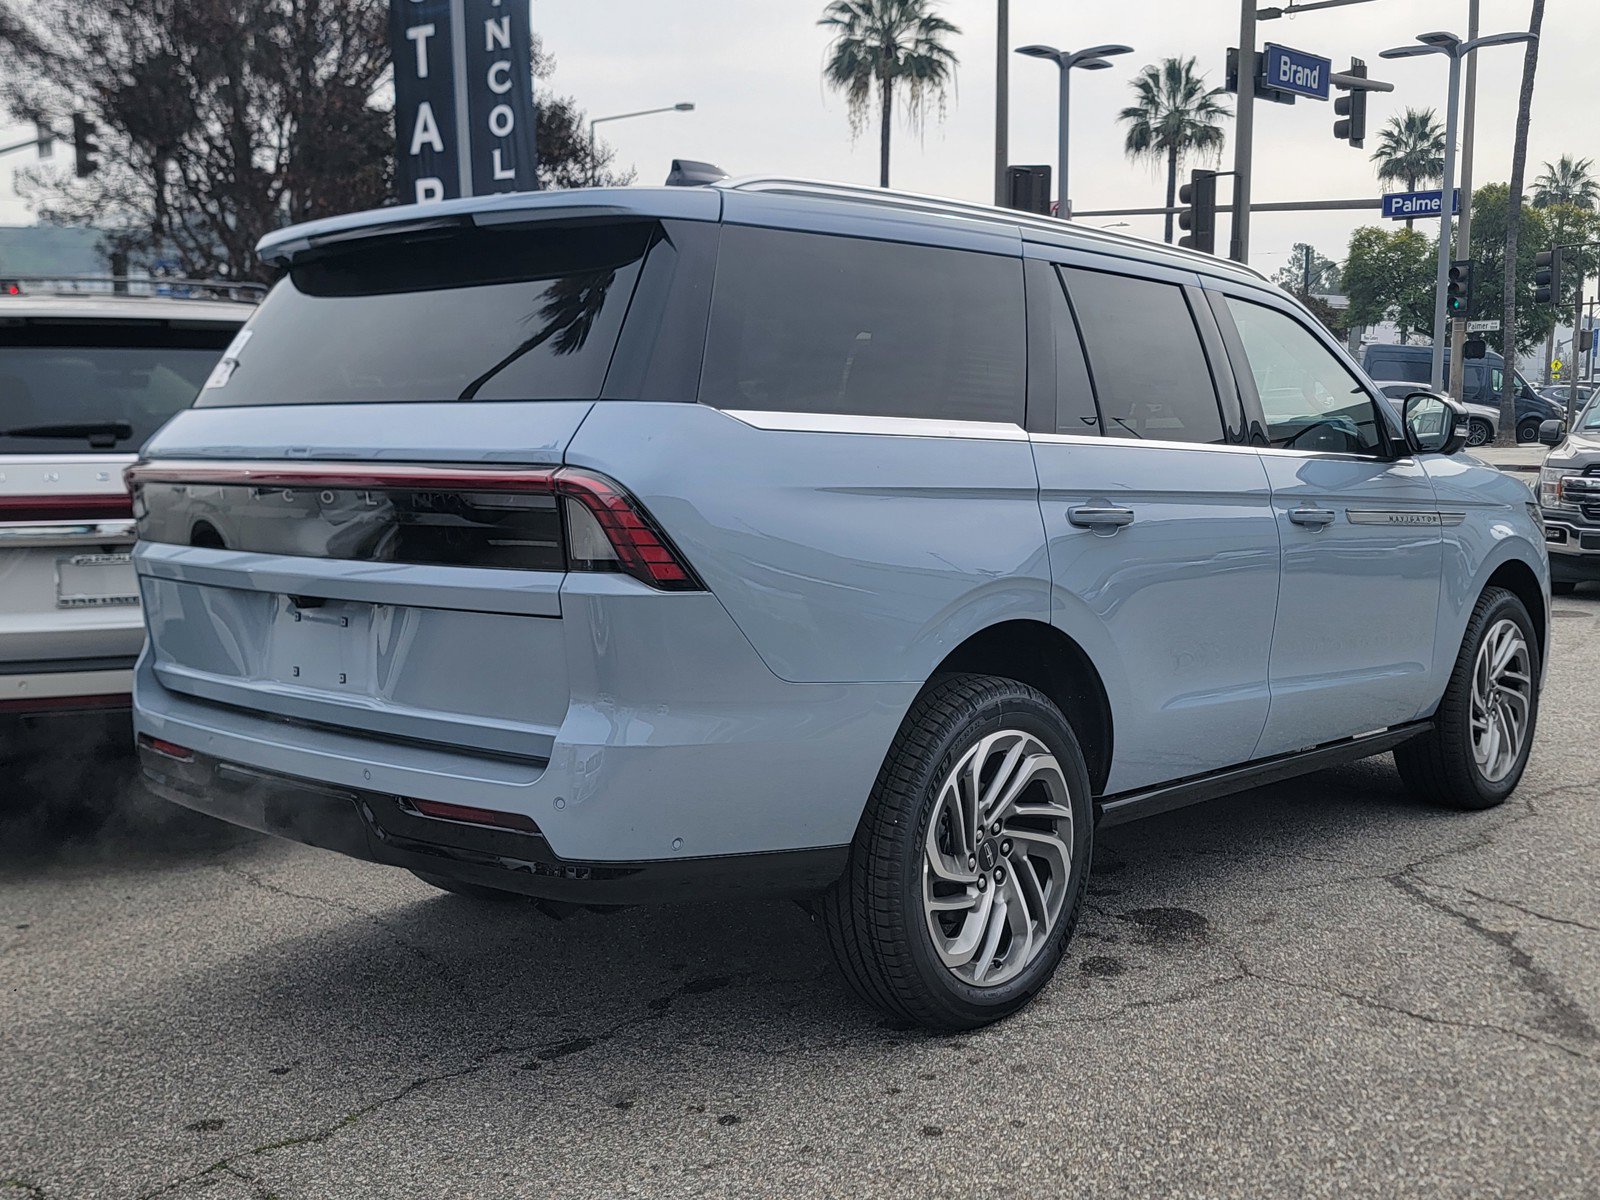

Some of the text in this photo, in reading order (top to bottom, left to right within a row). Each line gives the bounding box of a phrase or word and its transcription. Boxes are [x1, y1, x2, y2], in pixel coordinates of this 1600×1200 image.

[1280, 55, 1320, 89] Brand
[406, 0, 445, 204] TA
[485, 0, 517, 194] NCOL
[1391, 196, 1443, 213] Palme
[1467, 321, 1489, 330] Palmer
[1388, 515, 1437, 523] NAVIGATOR
